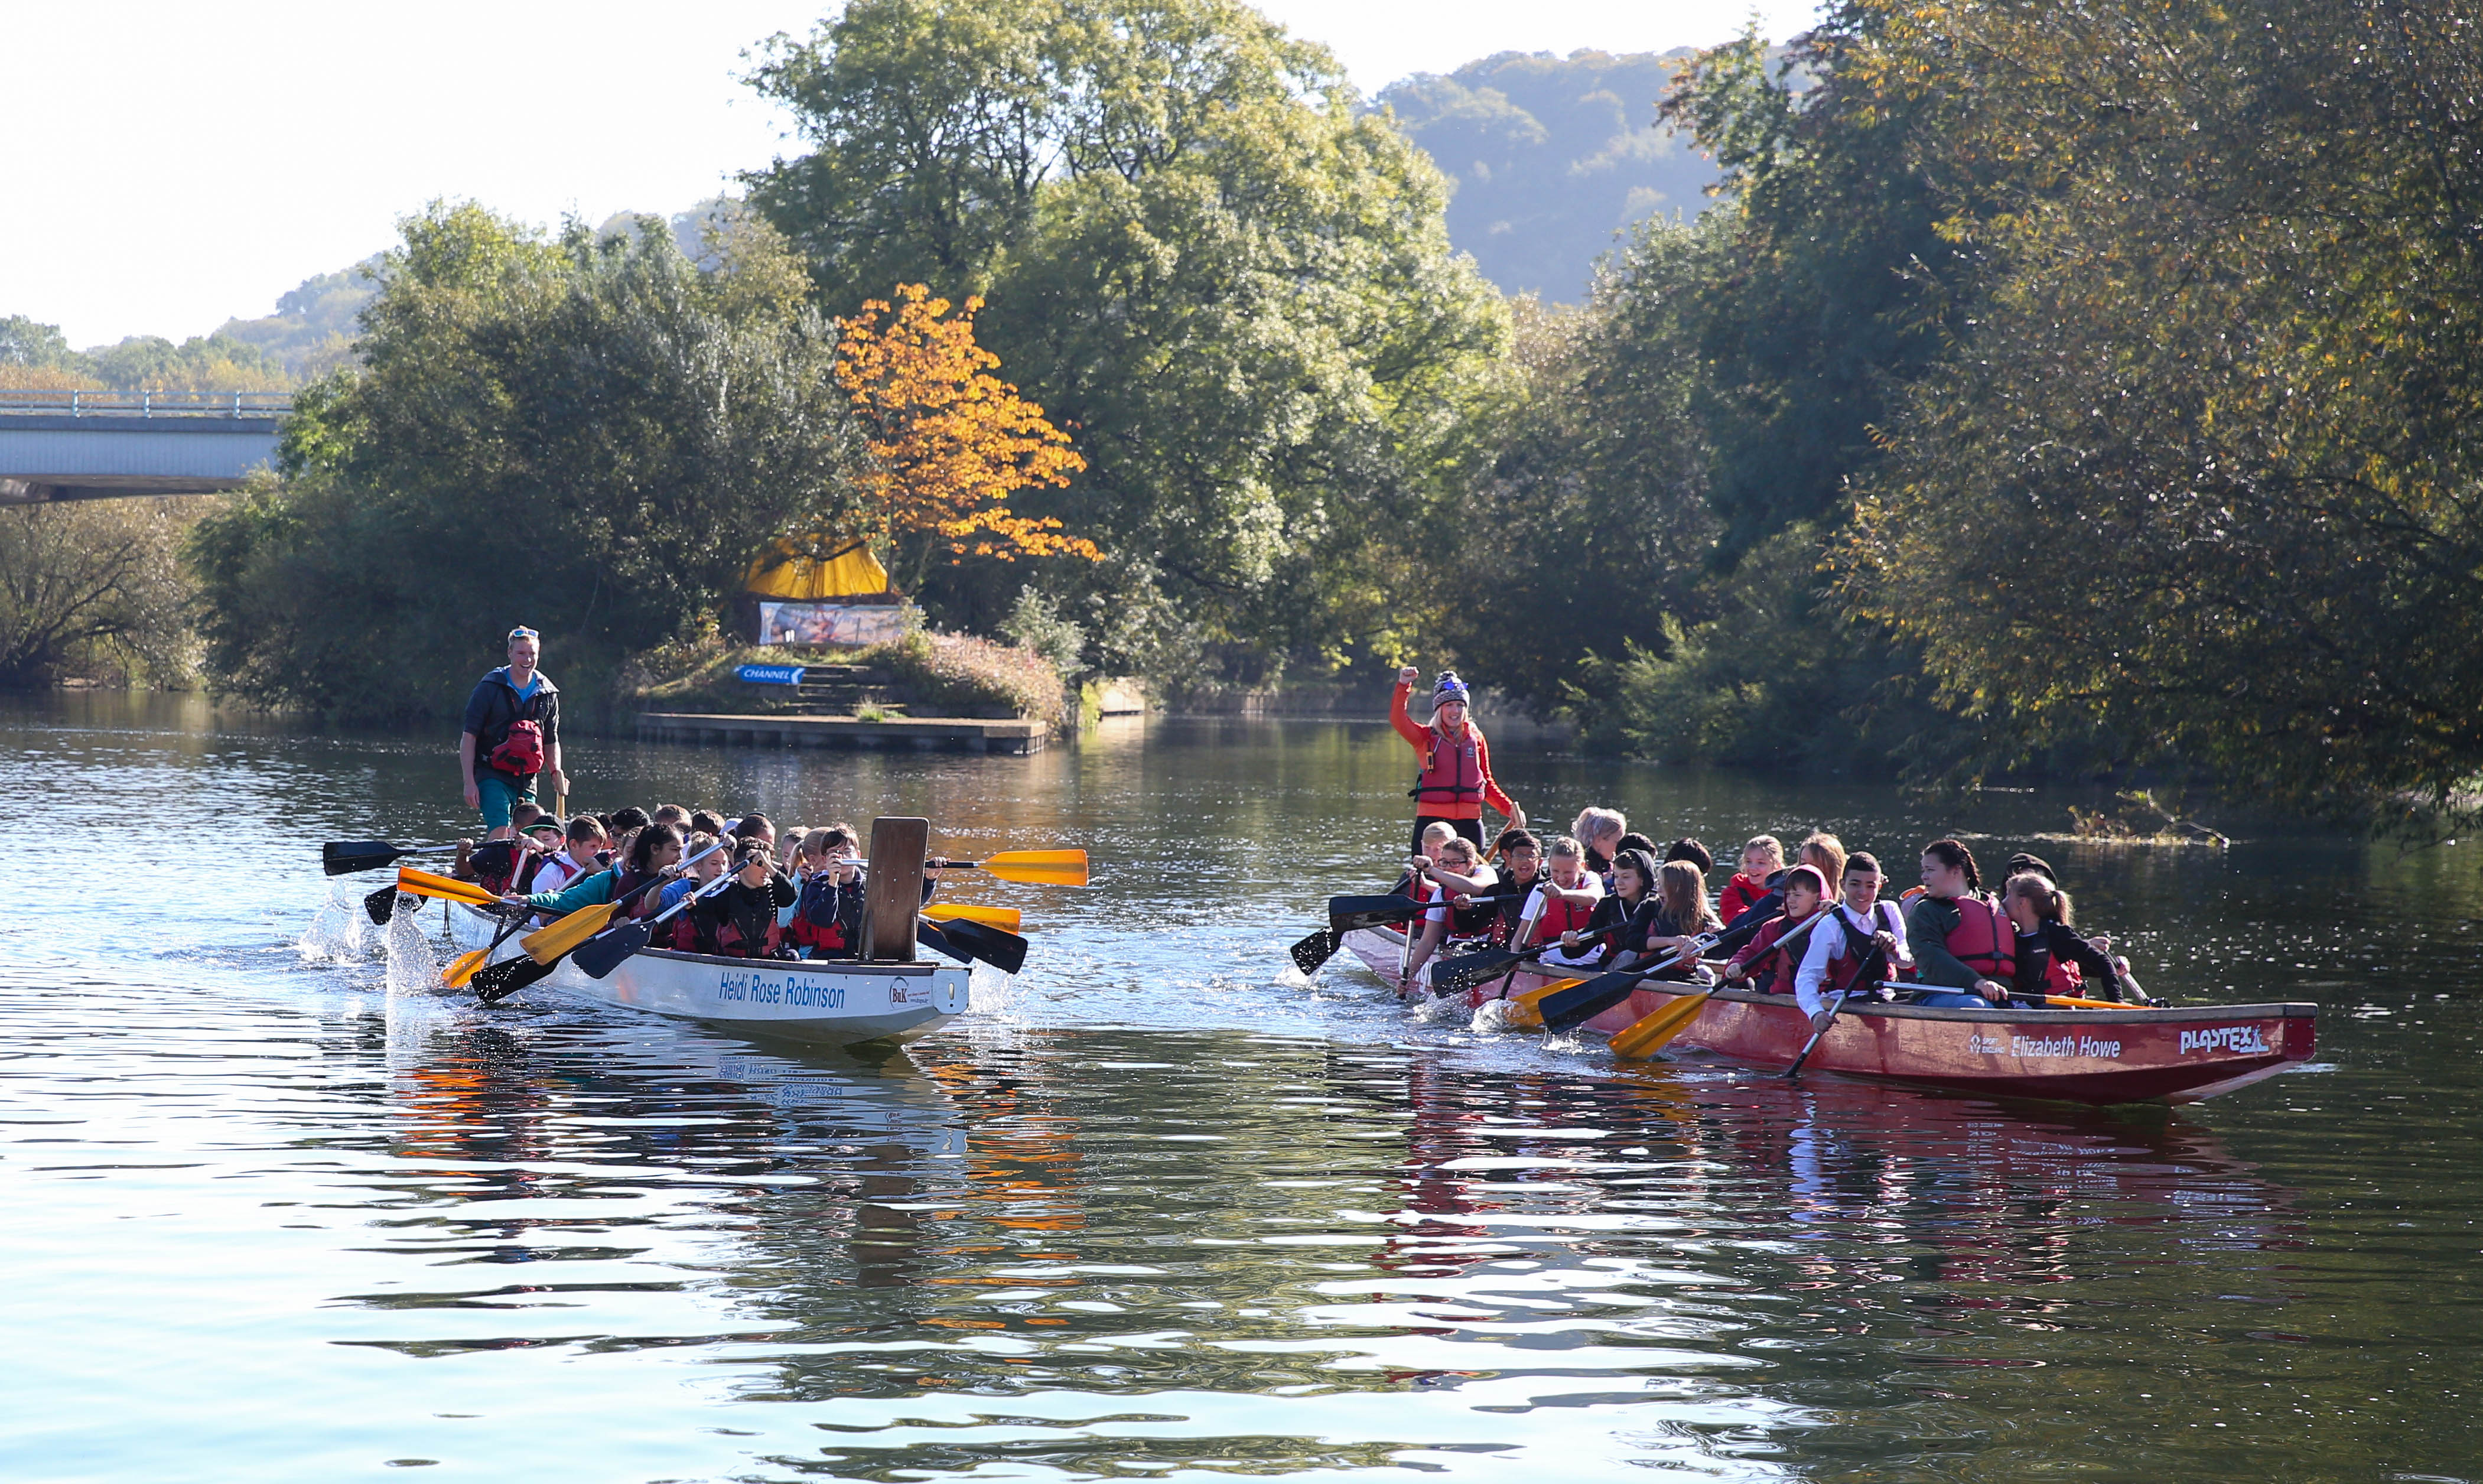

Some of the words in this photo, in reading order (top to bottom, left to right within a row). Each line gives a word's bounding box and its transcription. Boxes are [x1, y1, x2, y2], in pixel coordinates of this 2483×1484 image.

[744, 669, 789, 680] CHANNEL
[718, 972, 748, 1001] Heidi
[750, 974, 780, 1004] Rose
[785, 977, 845, 1009] Robinson
[2010, 1035, 2075, 1057] Elizabeth
[2079, 1036, 2121, 1058] Howe
